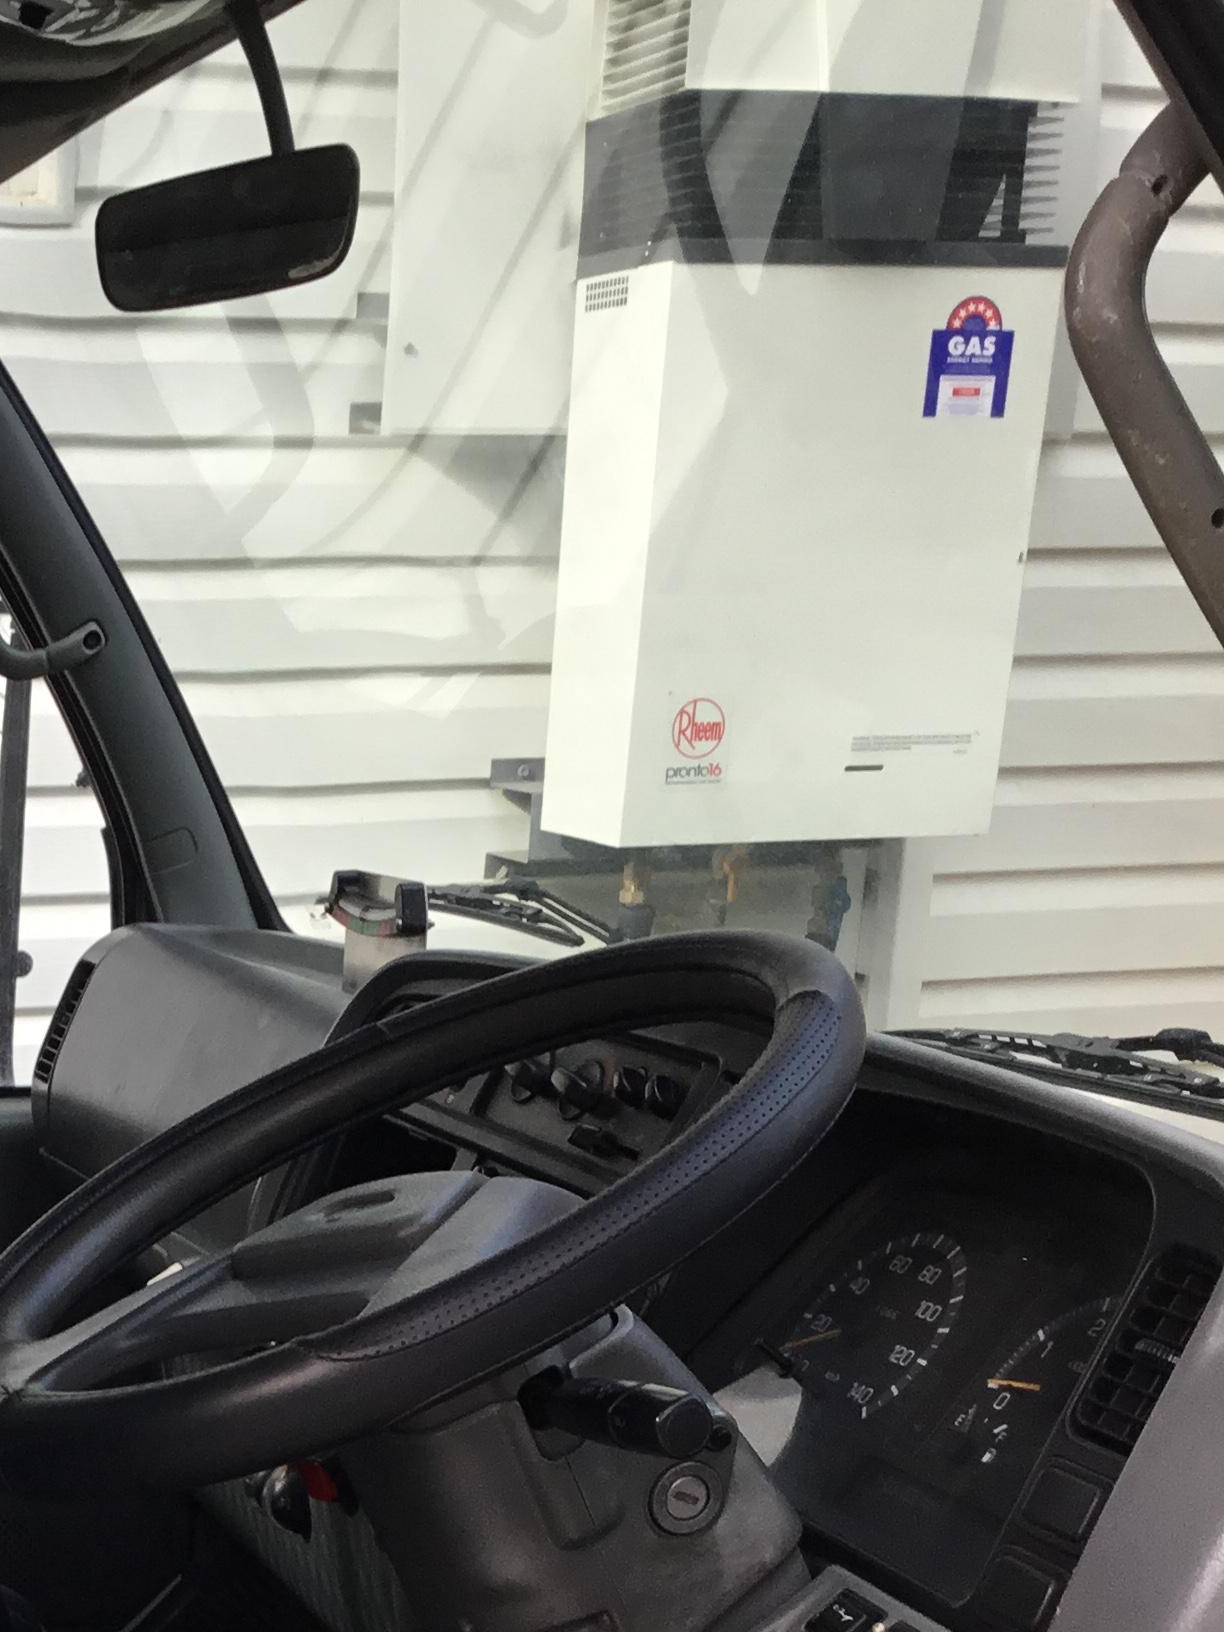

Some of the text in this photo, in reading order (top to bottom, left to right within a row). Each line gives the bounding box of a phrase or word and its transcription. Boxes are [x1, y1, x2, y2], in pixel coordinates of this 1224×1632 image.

[948, 336, 996, 356] GAS
[677, 699, 722, 750] Rheem
[665, 762, 722, 784] pronto16
[918, 1265, 942, 1285] 80
[915, 1300, 942, 1321] 100
[889, 1345, 915, 1366] 120
[847, 1382, 874, 1404] 140
[993, 1392, 1011, 1410] 0
